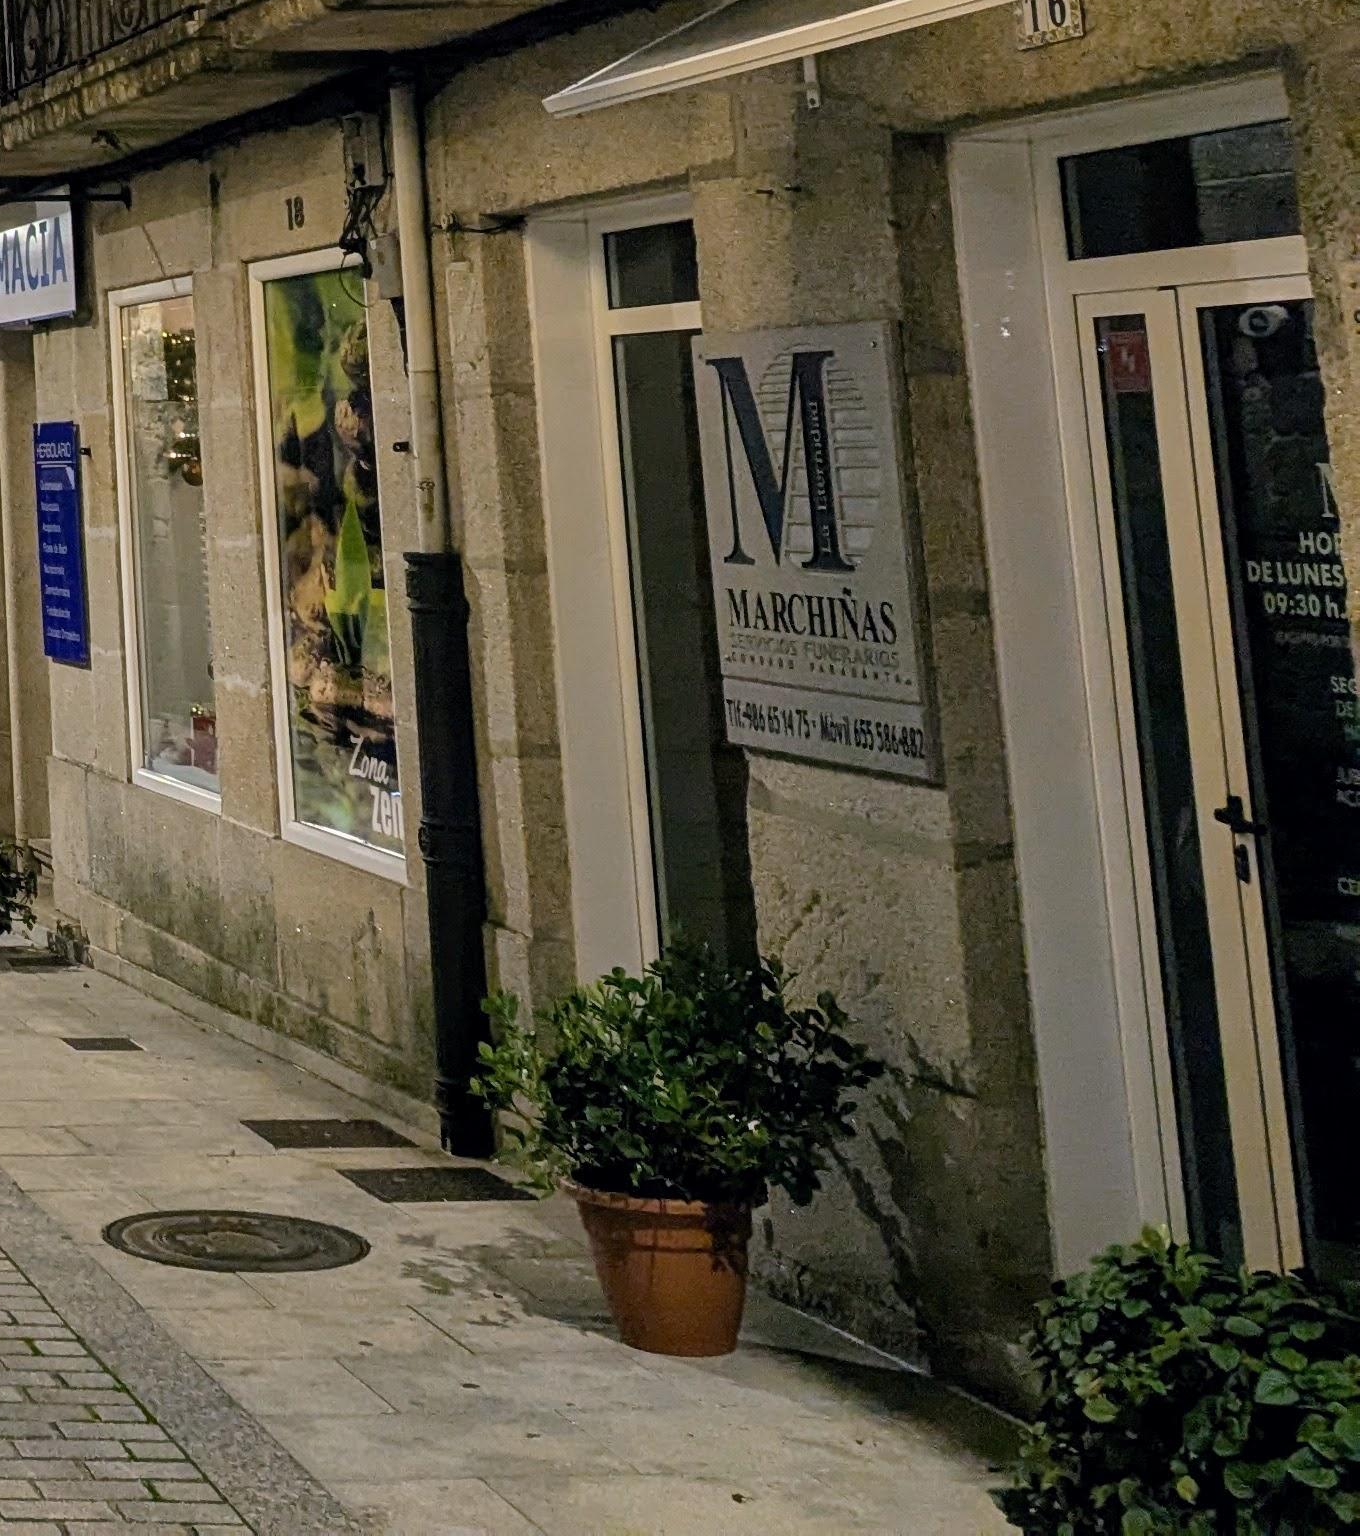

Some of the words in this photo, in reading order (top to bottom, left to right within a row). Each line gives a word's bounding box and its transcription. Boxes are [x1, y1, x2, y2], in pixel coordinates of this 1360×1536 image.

[285, 196, 305, 231] 18
[1247, 561, 1273, 583] DE
[1276, 561, 1344, 587] LUNES
[725, 586, 898, 646] MARCHIÑAS
[1263, 592, 1321, 617] 09:30
[803, 641, 899, 669] FUNERARIOS
[796, 709, 811, 740] 75
[854, 718, 875, 751] 655
[348, 733, 390, 785] Zona
